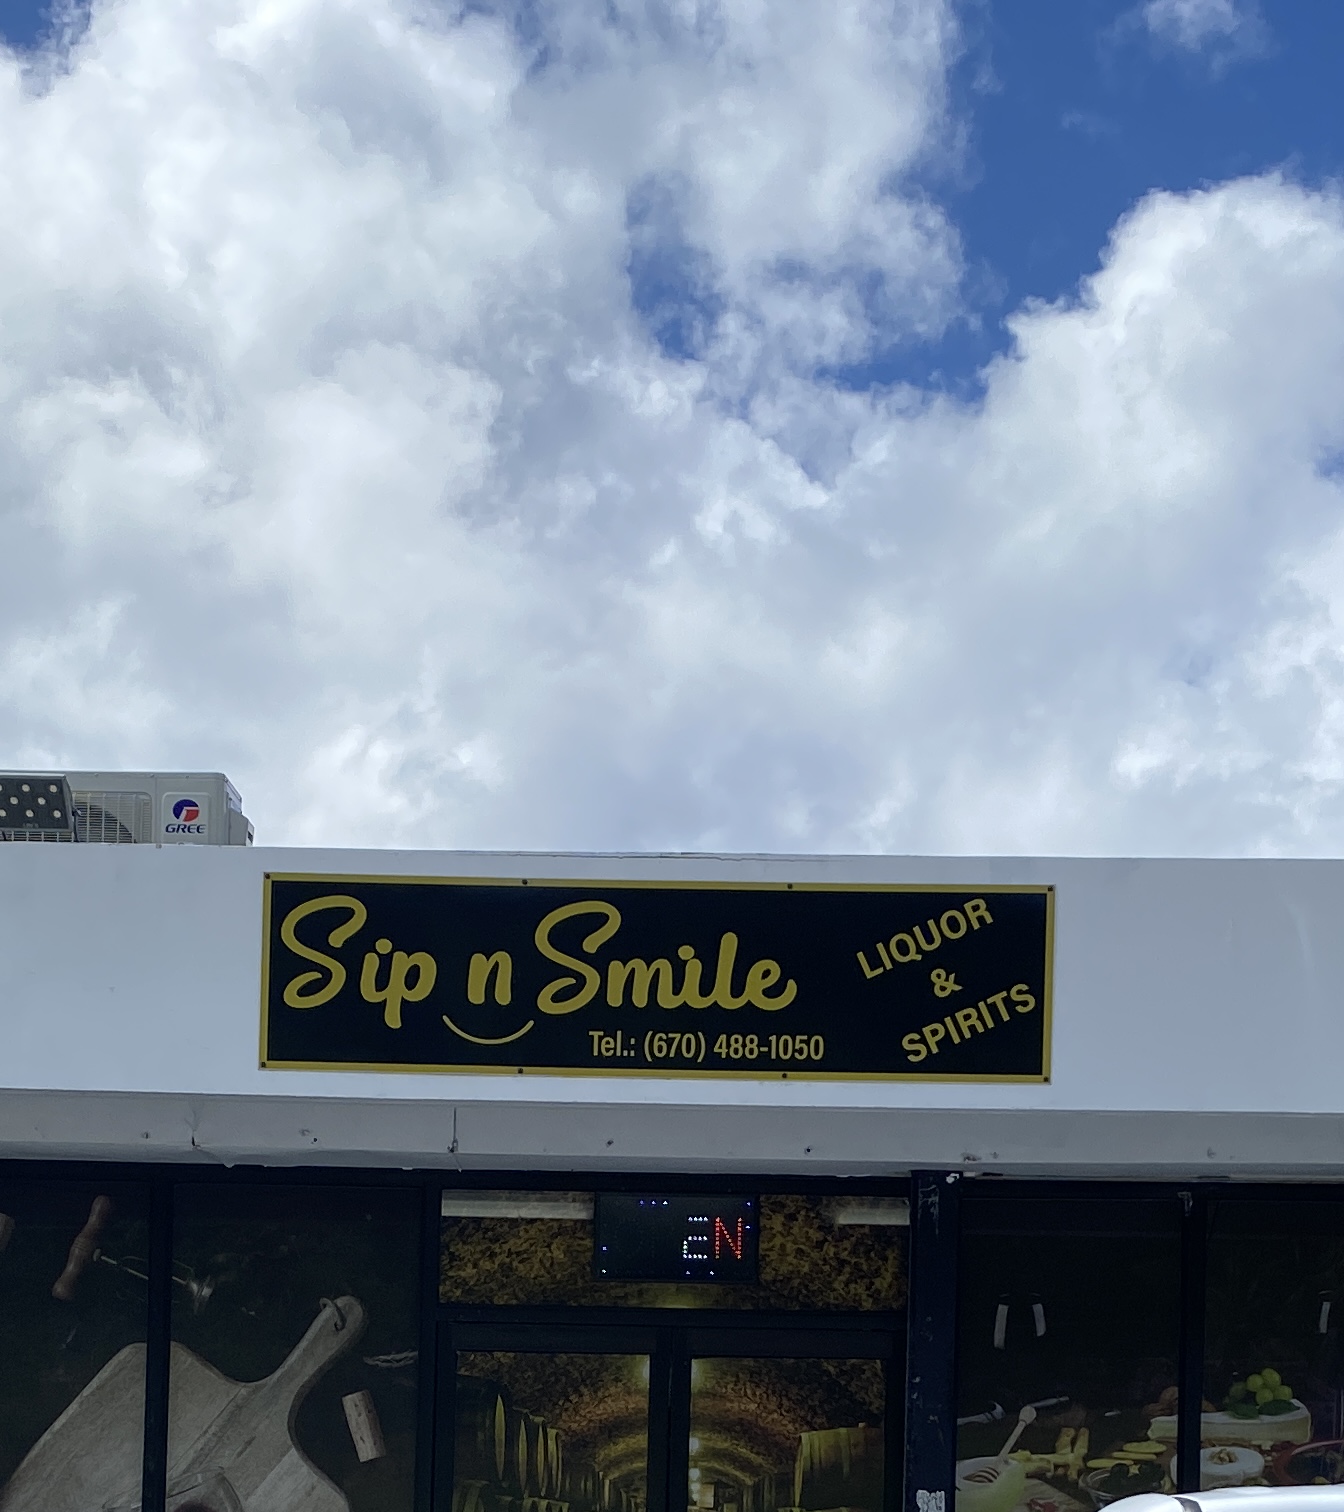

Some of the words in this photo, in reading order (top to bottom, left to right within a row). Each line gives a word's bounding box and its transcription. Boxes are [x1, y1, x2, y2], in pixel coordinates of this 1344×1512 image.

[165, 823, 206, 834] GREE
[280, 894, 437, 1029] Sip
[467, 951, 512, 1006] n
[534, 900, 797, 1015] Smile
[856, 898, 994, 980] LIQUOR
[930, 968, 963, 998] &
[588, 1030, 636, 1057] Tel.:
[644, 1030, 706, 1062] (670)
[713, 1034, 825, 1060] 488-1050
[901, 983, 1036, 1063] SPIRITS
